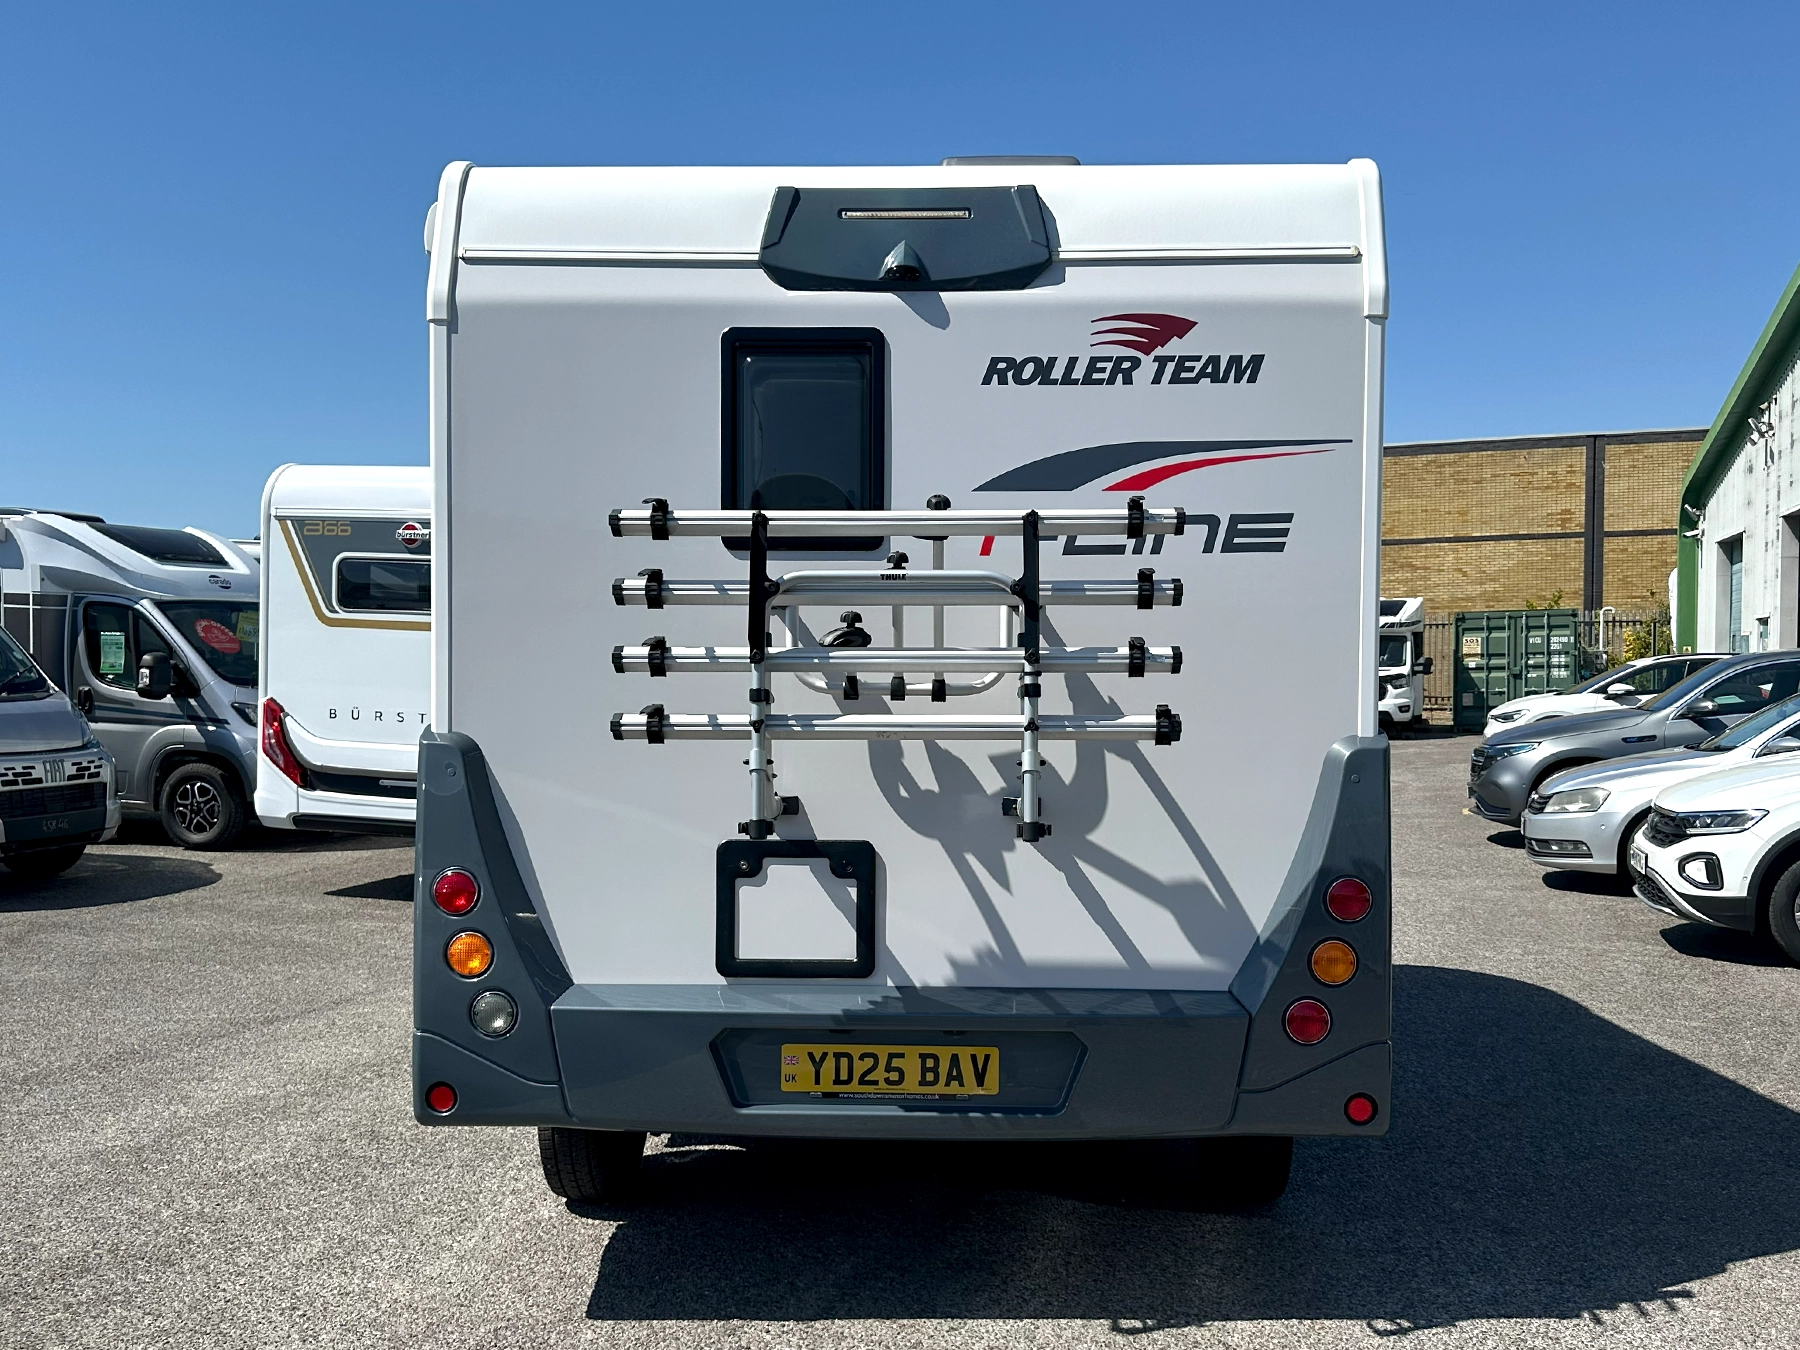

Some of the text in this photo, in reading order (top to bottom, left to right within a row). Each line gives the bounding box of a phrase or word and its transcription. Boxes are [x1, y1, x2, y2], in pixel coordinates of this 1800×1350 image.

[980, 354, 1265, 386] ROLLER TEAM
[396, 529, 430, 539] bürstner
[880, 573, 907, 581] THULE
[42, 759, 66, 783] FIAT
[784, 1074, 797, 1083] UK
[807, 1052, 991, 1088] YD25 BAV
